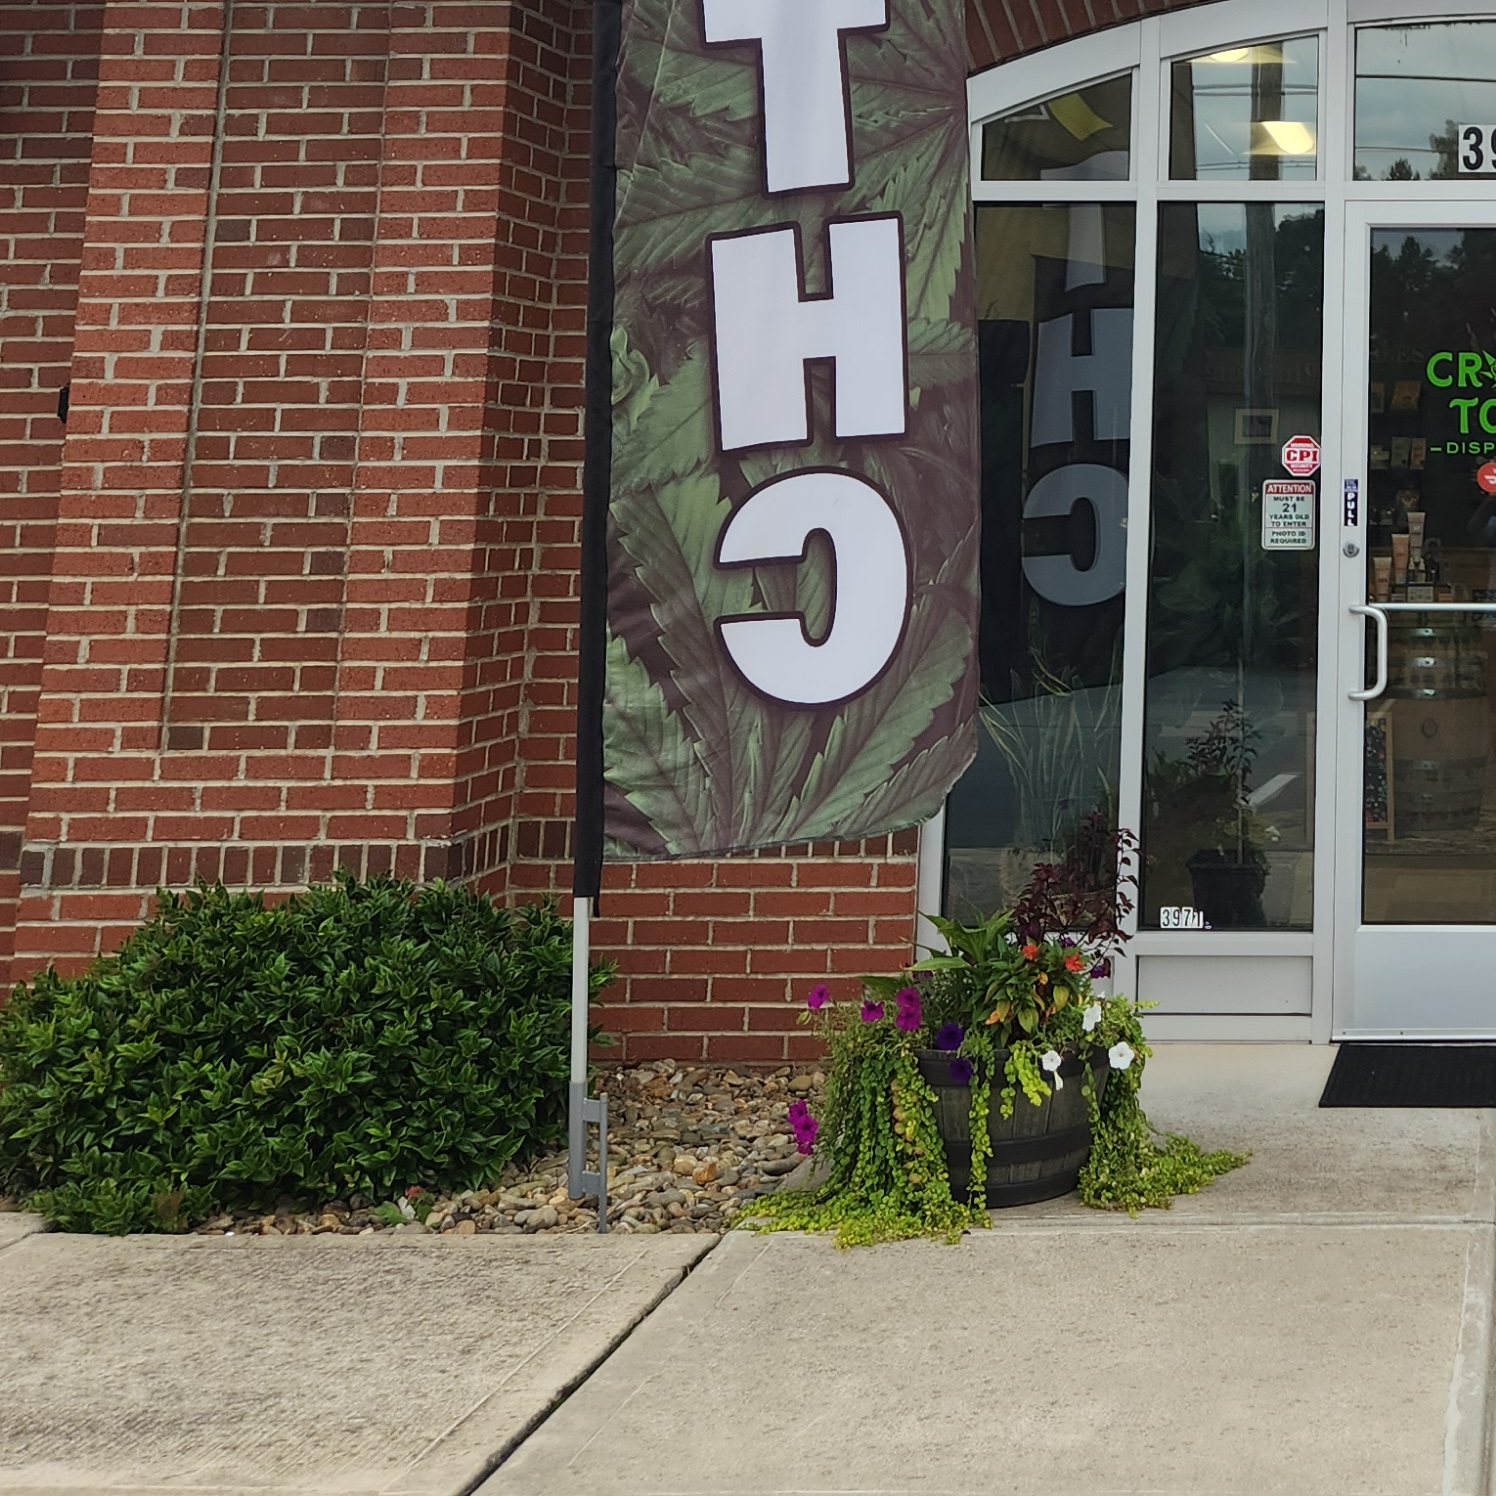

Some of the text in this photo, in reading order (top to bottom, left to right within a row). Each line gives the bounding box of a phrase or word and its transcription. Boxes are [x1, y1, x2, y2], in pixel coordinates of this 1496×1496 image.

[1286, 449, 1318, 462] CPI
[1267, 484, 1312, 493] ATTENTION
[1282, 503, 1297, 513] 21
[1347, 492, 1355, 526] PULL
